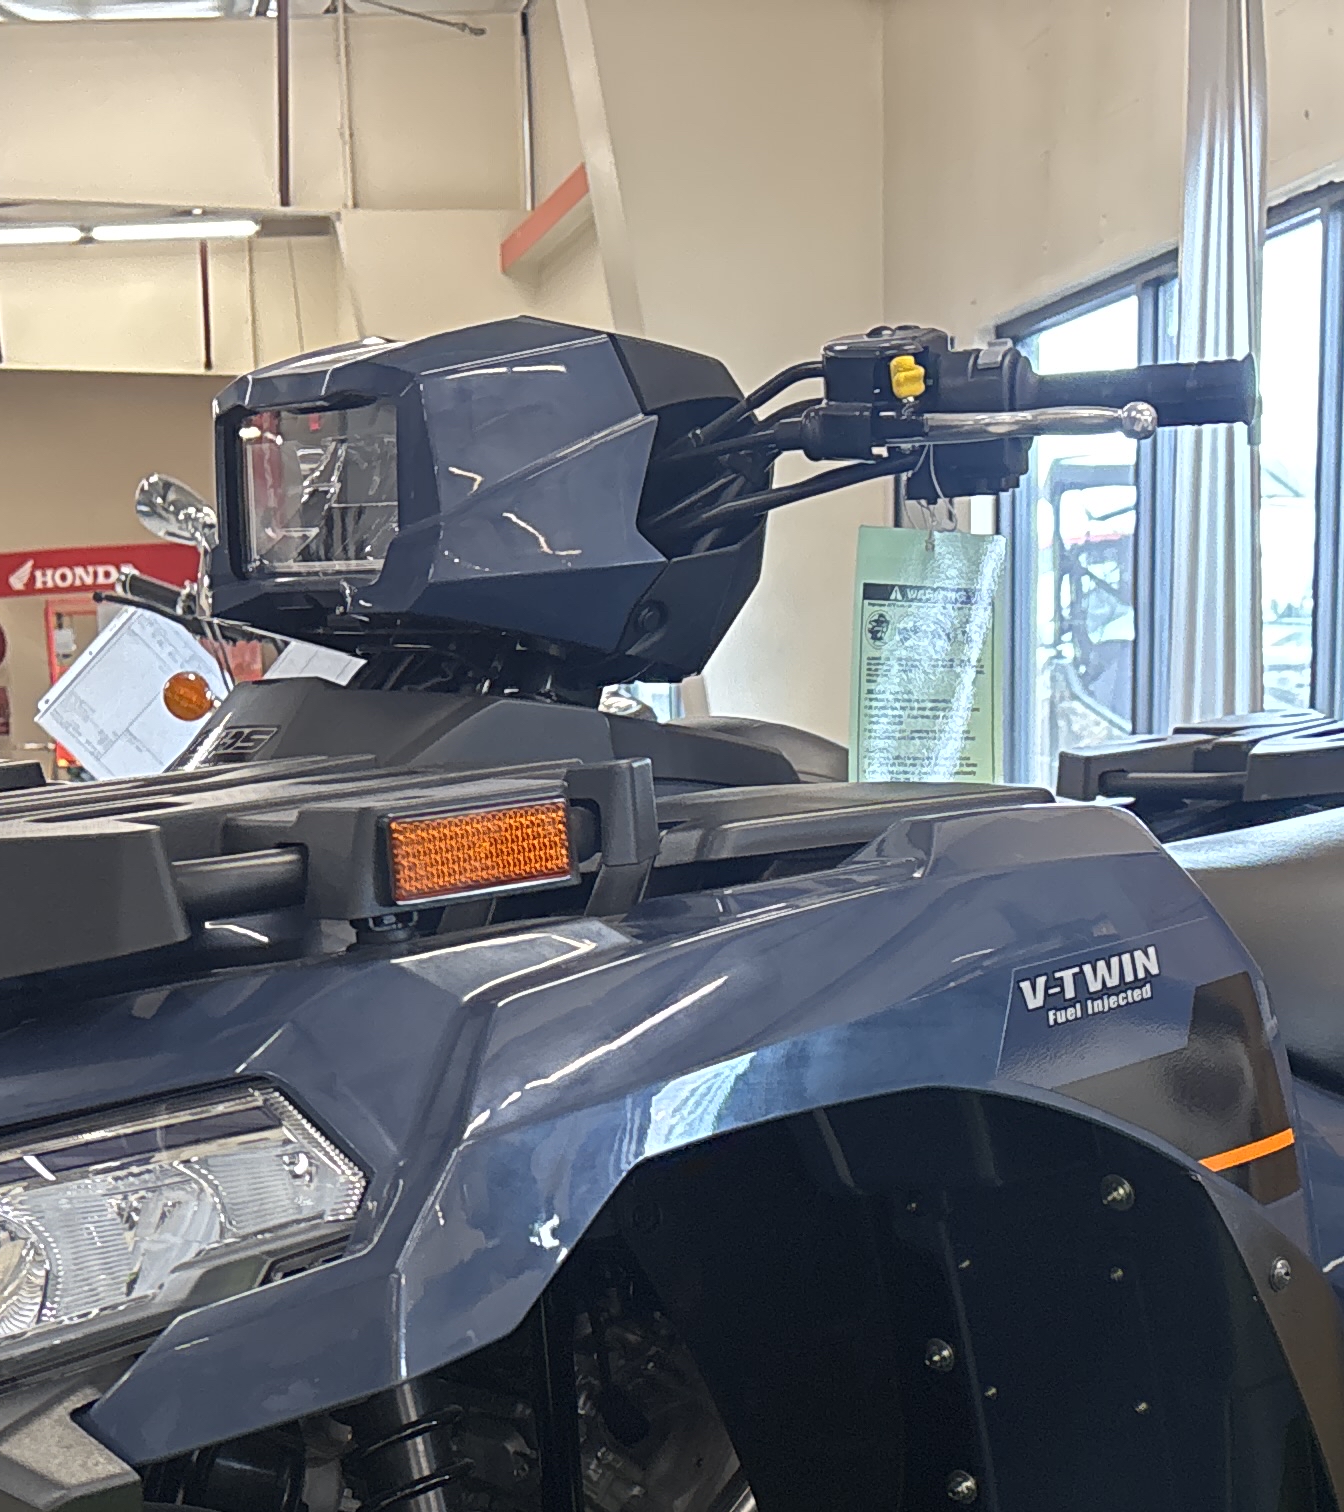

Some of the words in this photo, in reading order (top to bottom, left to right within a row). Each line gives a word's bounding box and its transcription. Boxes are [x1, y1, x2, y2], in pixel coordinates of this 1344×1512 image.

[34, 564, 121, 590] HOND
[1018, 945, 1160, 1010] V-TWIN
[1047, 1002, 1082, 1027] Fuel
[1086, 982, 1153, 1015] Injected
